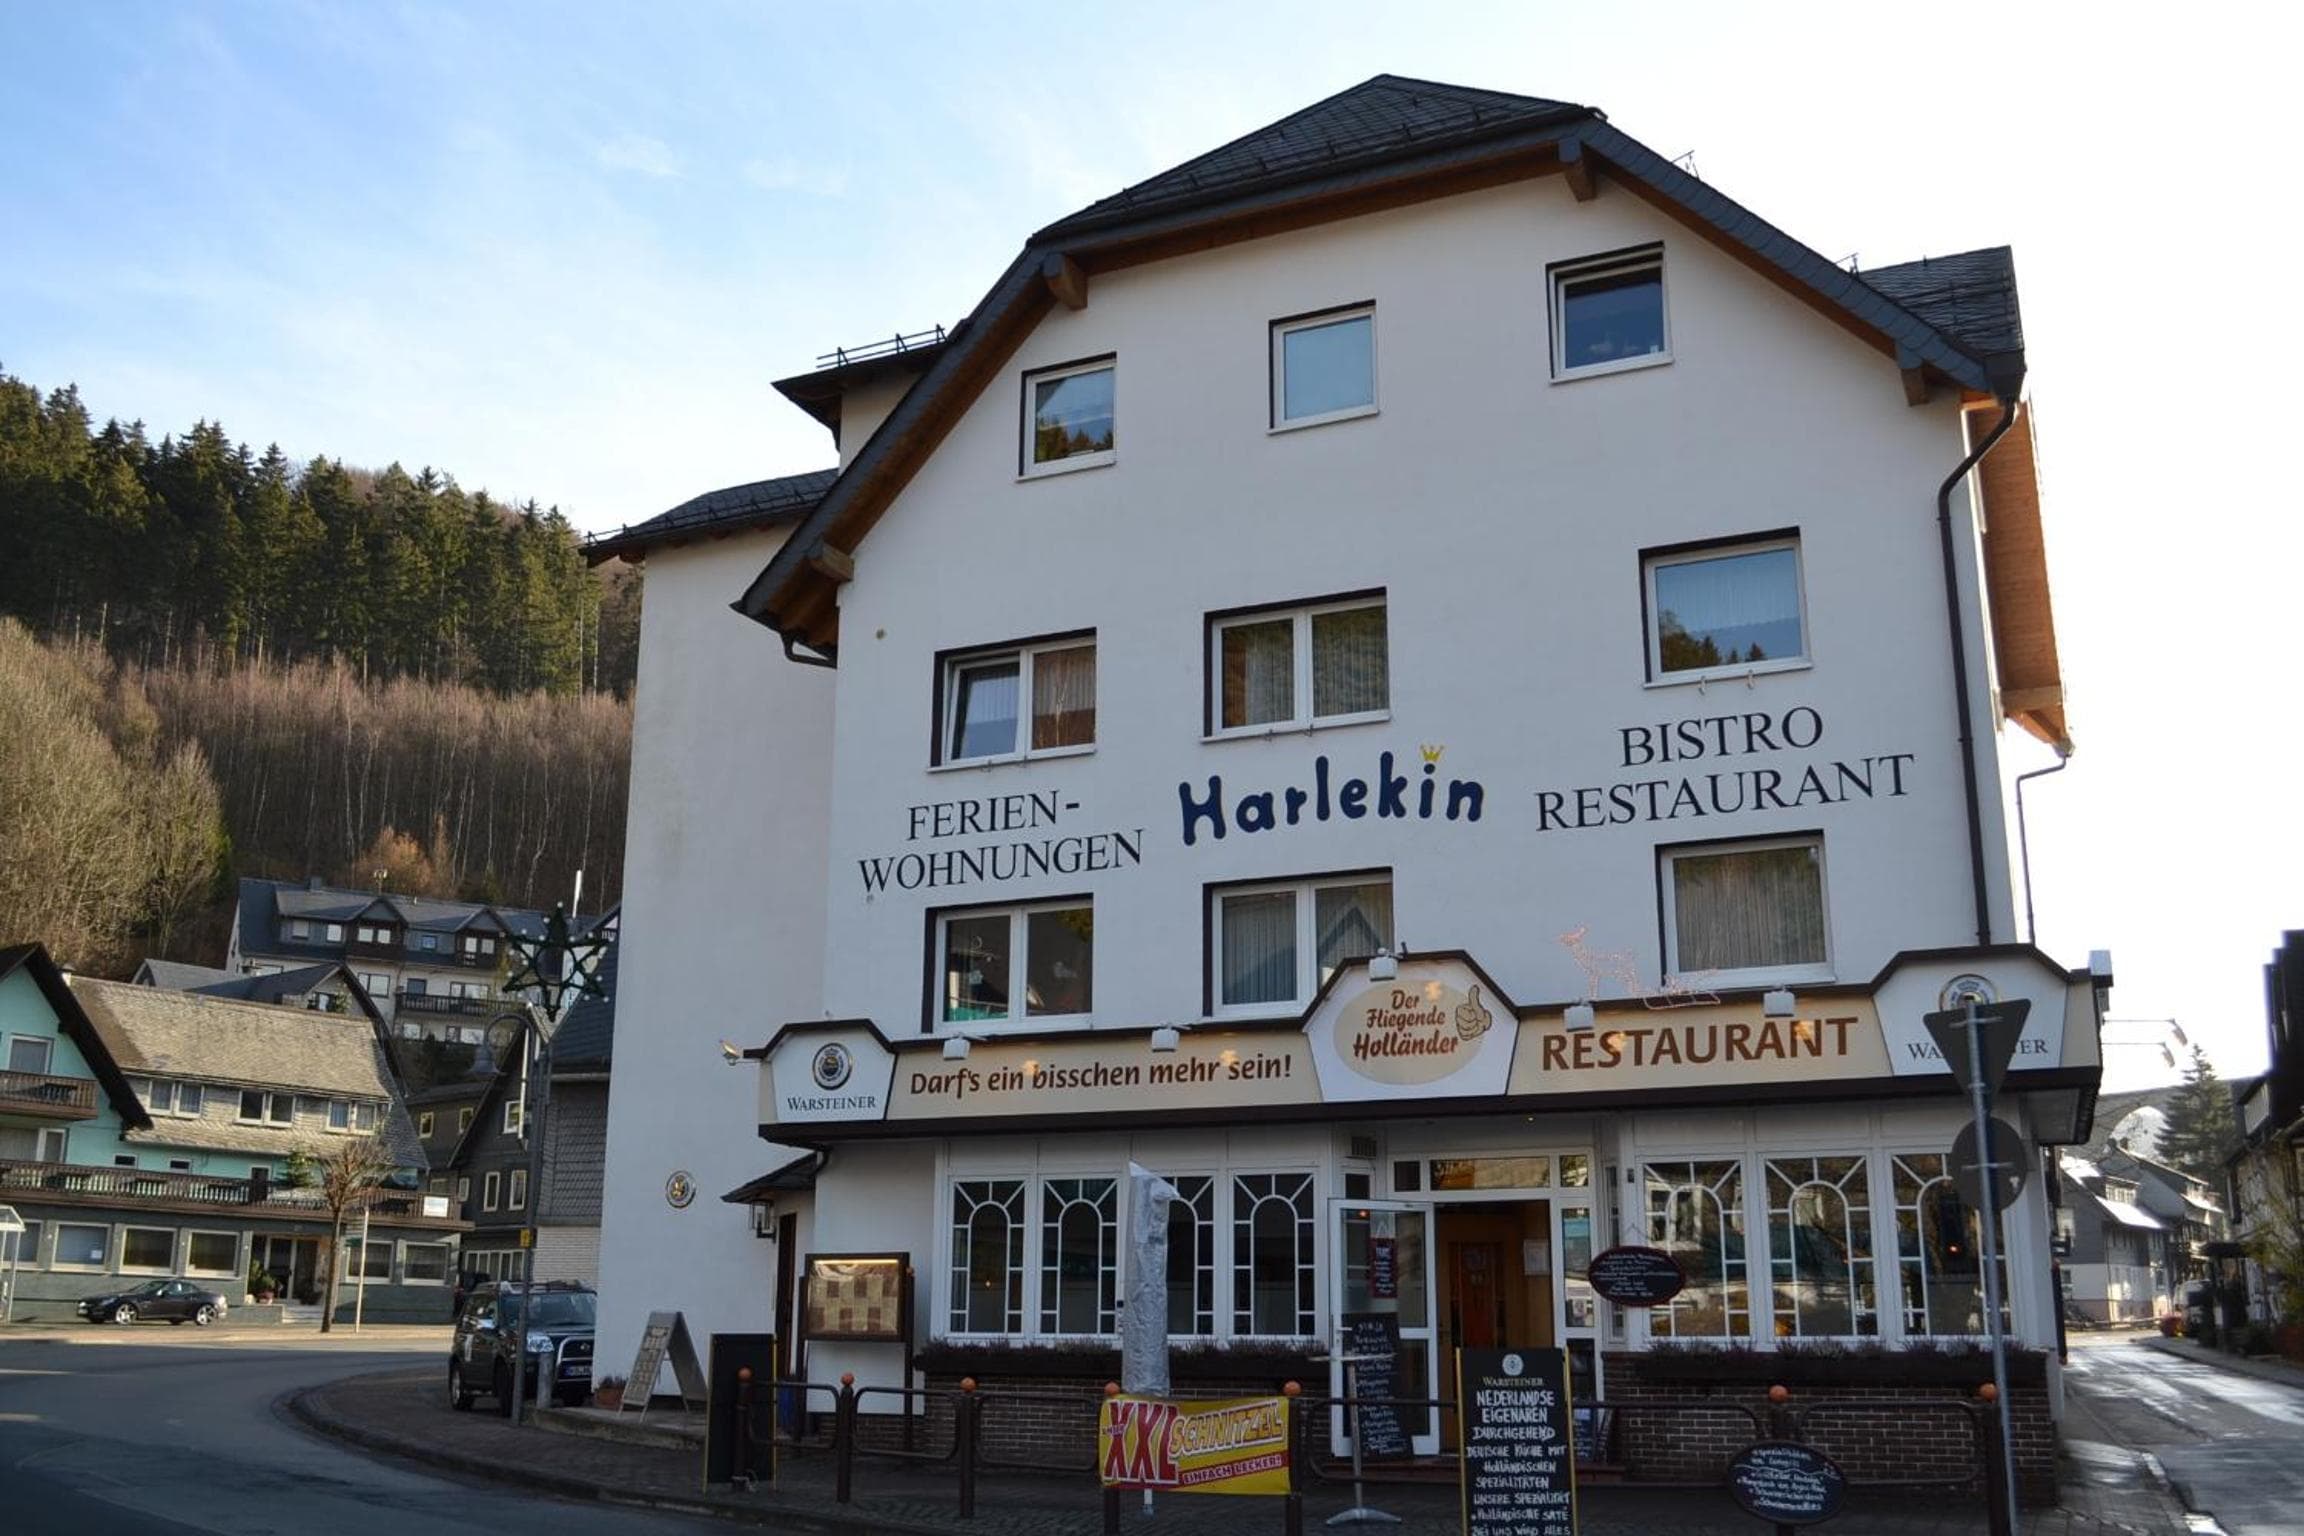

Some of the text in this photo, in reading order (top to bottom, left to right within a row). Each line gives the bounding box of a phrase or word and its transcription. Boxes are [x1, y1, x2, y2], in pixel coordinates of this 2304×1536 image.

[1619, 706, 1824, 768] BISTRO
[906, 788, 1081, 842] FERIEN-
[1178, 750, 1484, 847] Harlekin
[1535, 753, 1915, 832] RESTAURANT
[858, 828, 1144, 893] WOHNUNGEN
[1366, 1006, 1446, 1031] Fliegende
[1390, 990, 1421, 1010] Der
[1353, 1030, 1459, 1061] Holländer
[1542, 1017, 1859, 1072] RESTAURANT
[911, 1053, 1292, 1099] Darf's ein bisschen mehr sein!
[787, 1096, 876, 1111] WARSTEINER
[1476, 1389, 1555, 1407] NEDERLANDSE
[1103, 1401, 1180, 1483] XXL
